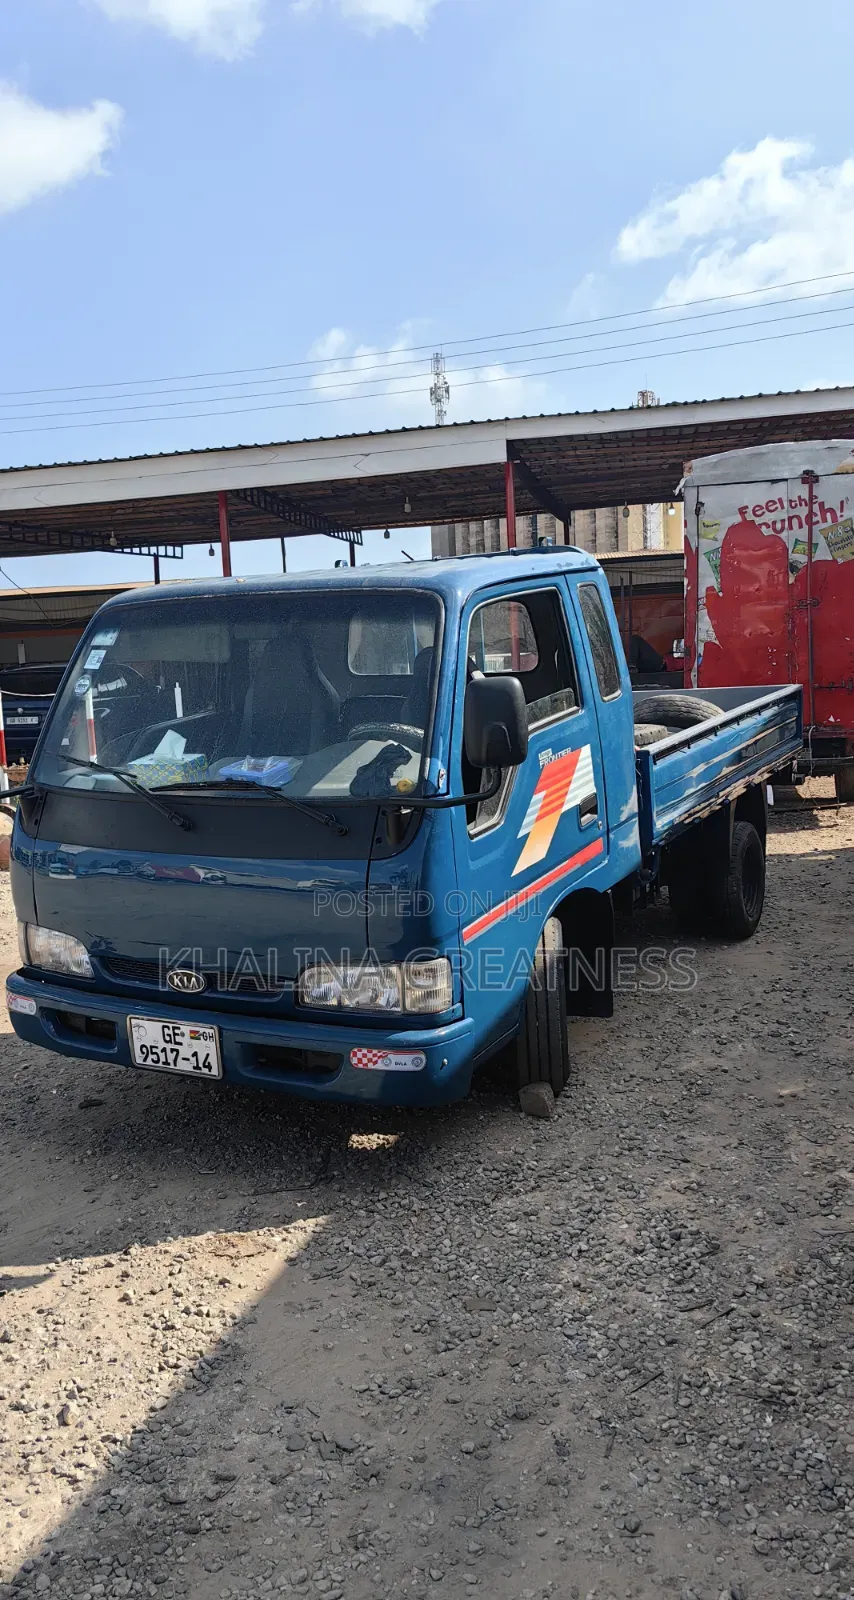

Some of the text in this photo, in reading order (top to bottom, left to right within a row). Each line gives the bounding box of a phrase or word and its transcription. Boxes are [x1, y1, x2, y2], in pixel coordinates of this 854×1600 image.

[737, 494, 819, 521] Feel the
[757, 499, 845, 535] runch!
[539, 747, 572, 769] FRONTIER
[173, 976, 199, 990] KIA
[161, 1024, 215, 1046] GE GH
[139, 1043, 213, 1073] 9517-14
